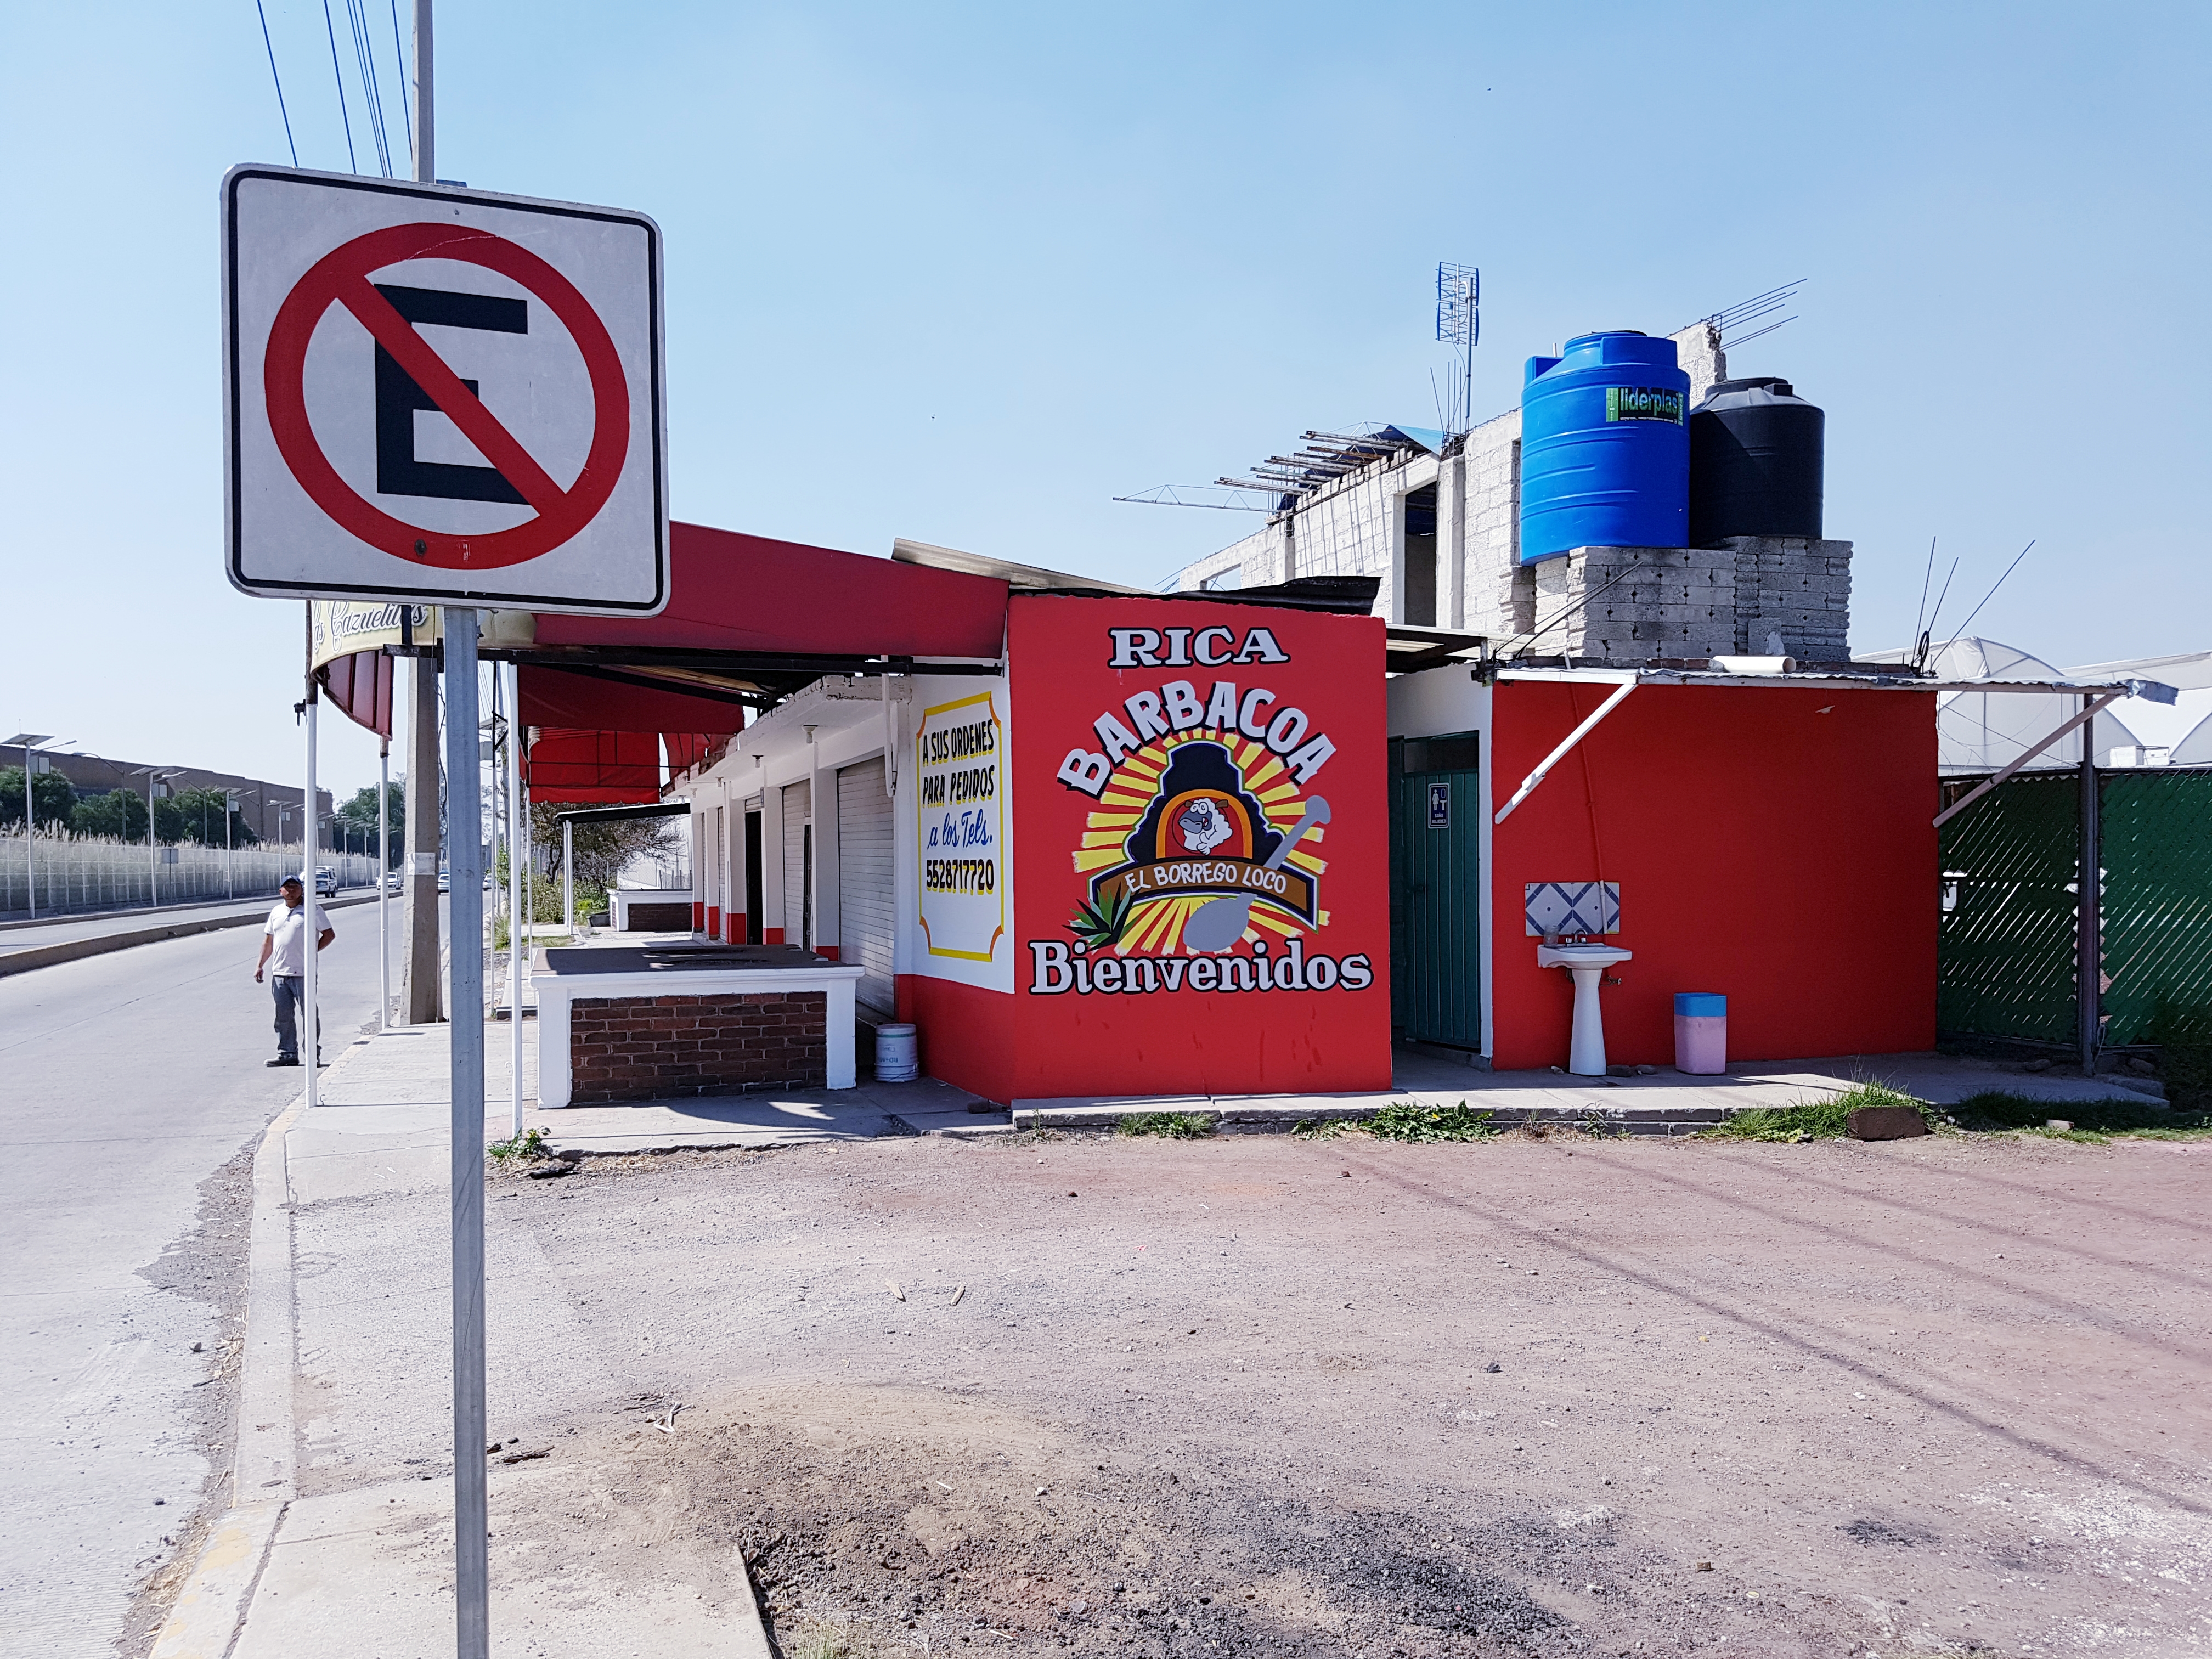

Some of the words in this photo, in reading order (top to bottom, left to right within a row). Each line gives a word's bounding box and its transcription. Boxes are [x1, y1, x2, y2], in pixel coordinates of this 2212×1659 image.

[1620, 388, 1678, 417] liderplas
[1108, 627, 1290, 668] RICA
[923, 734, 929, 765] A
[931, 729, 949, 763] SUS
[951, 718, 994, 759] ORDENES
[1056, 680, 1337, 798] BARBACOA
[922, 774, 945, 806] PARA
[949, 764, 995, 804] PEDIDOS
[927, 827, 939, 850] a
[942, 812, 960, 848] los
[961, 808, 992, 848] Tels.
[926, 859, 995, 893] 5528717720
[1125, 870, 1151, 893] EL
[1154, 862, 1238, 887] BORREGO
[1242, 866, 1287, 894] LOCO
[1028, 938, 1373, 996] Bienvenidos
